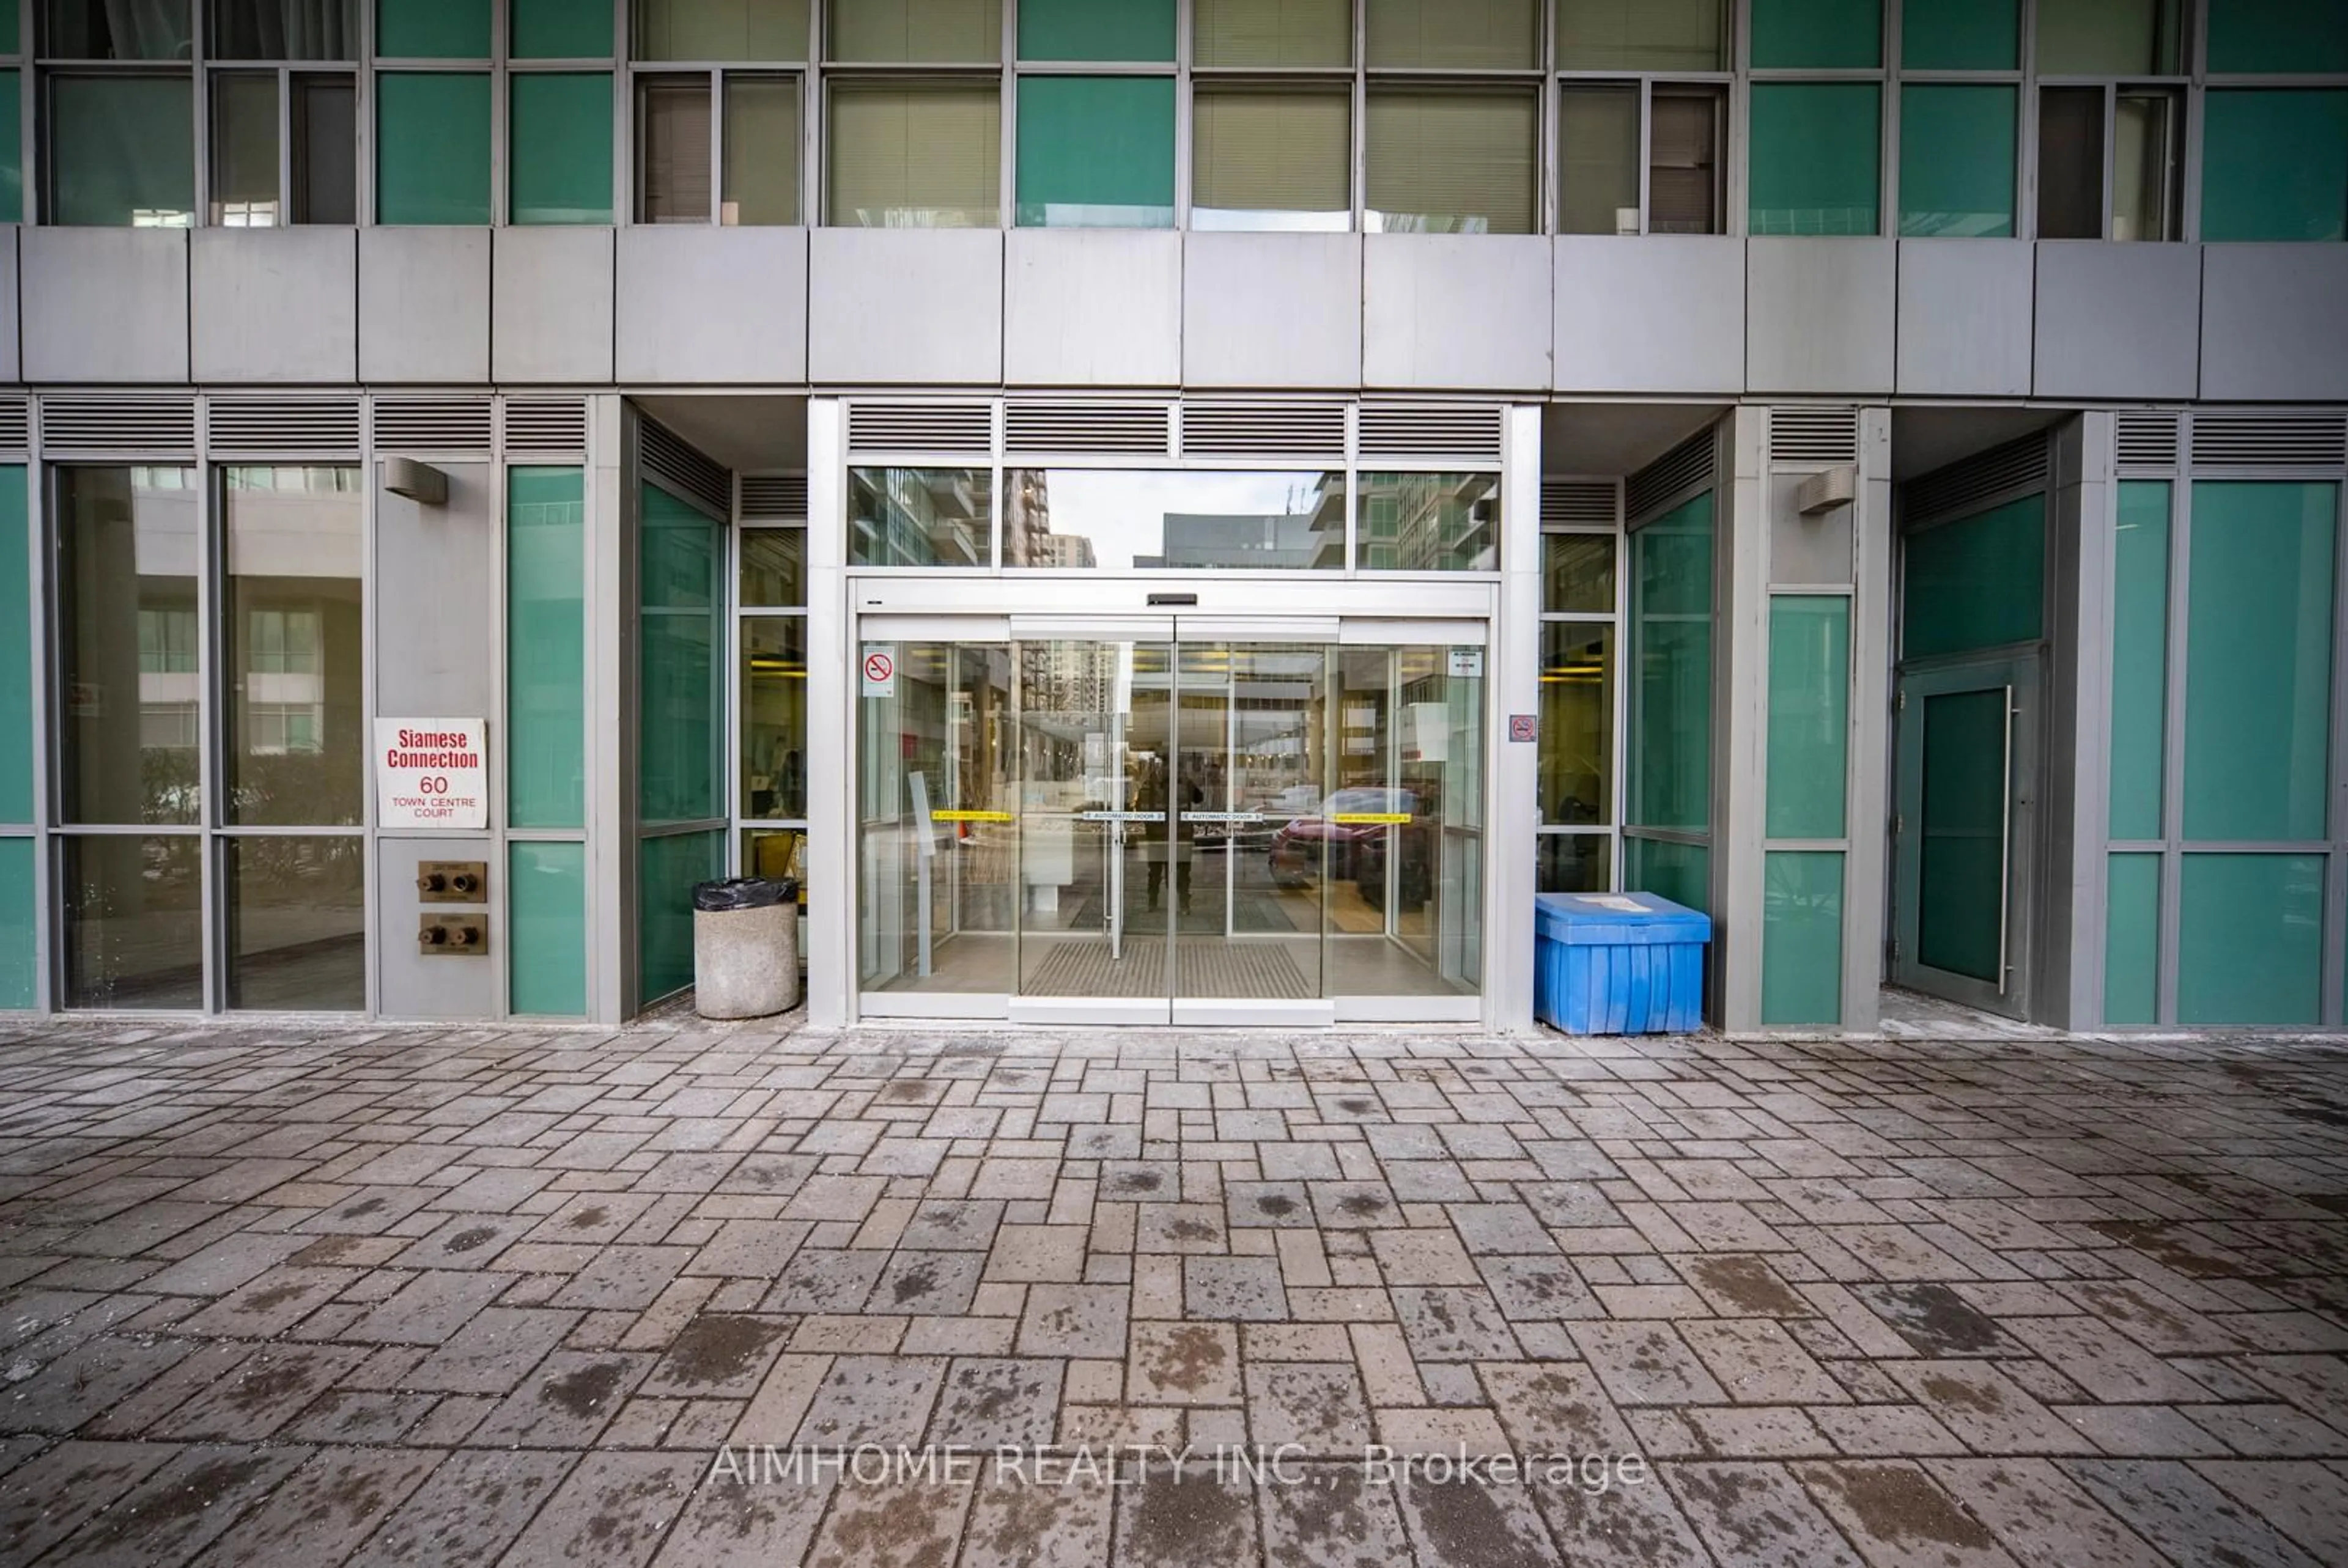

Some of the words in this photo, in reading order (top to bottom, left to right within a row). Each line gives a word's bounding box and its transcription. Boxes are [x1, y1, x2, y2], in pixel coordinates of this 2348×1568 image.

[399, 729, 467, 748] Siamese
[387, 749, 478, 768] Connection
[420, 776, 448, 793] 60
[393, 798, 426, 807] TOWN
[430, 798, 476, 807] CENTRE
[414, 809, 454, 818] COURT
